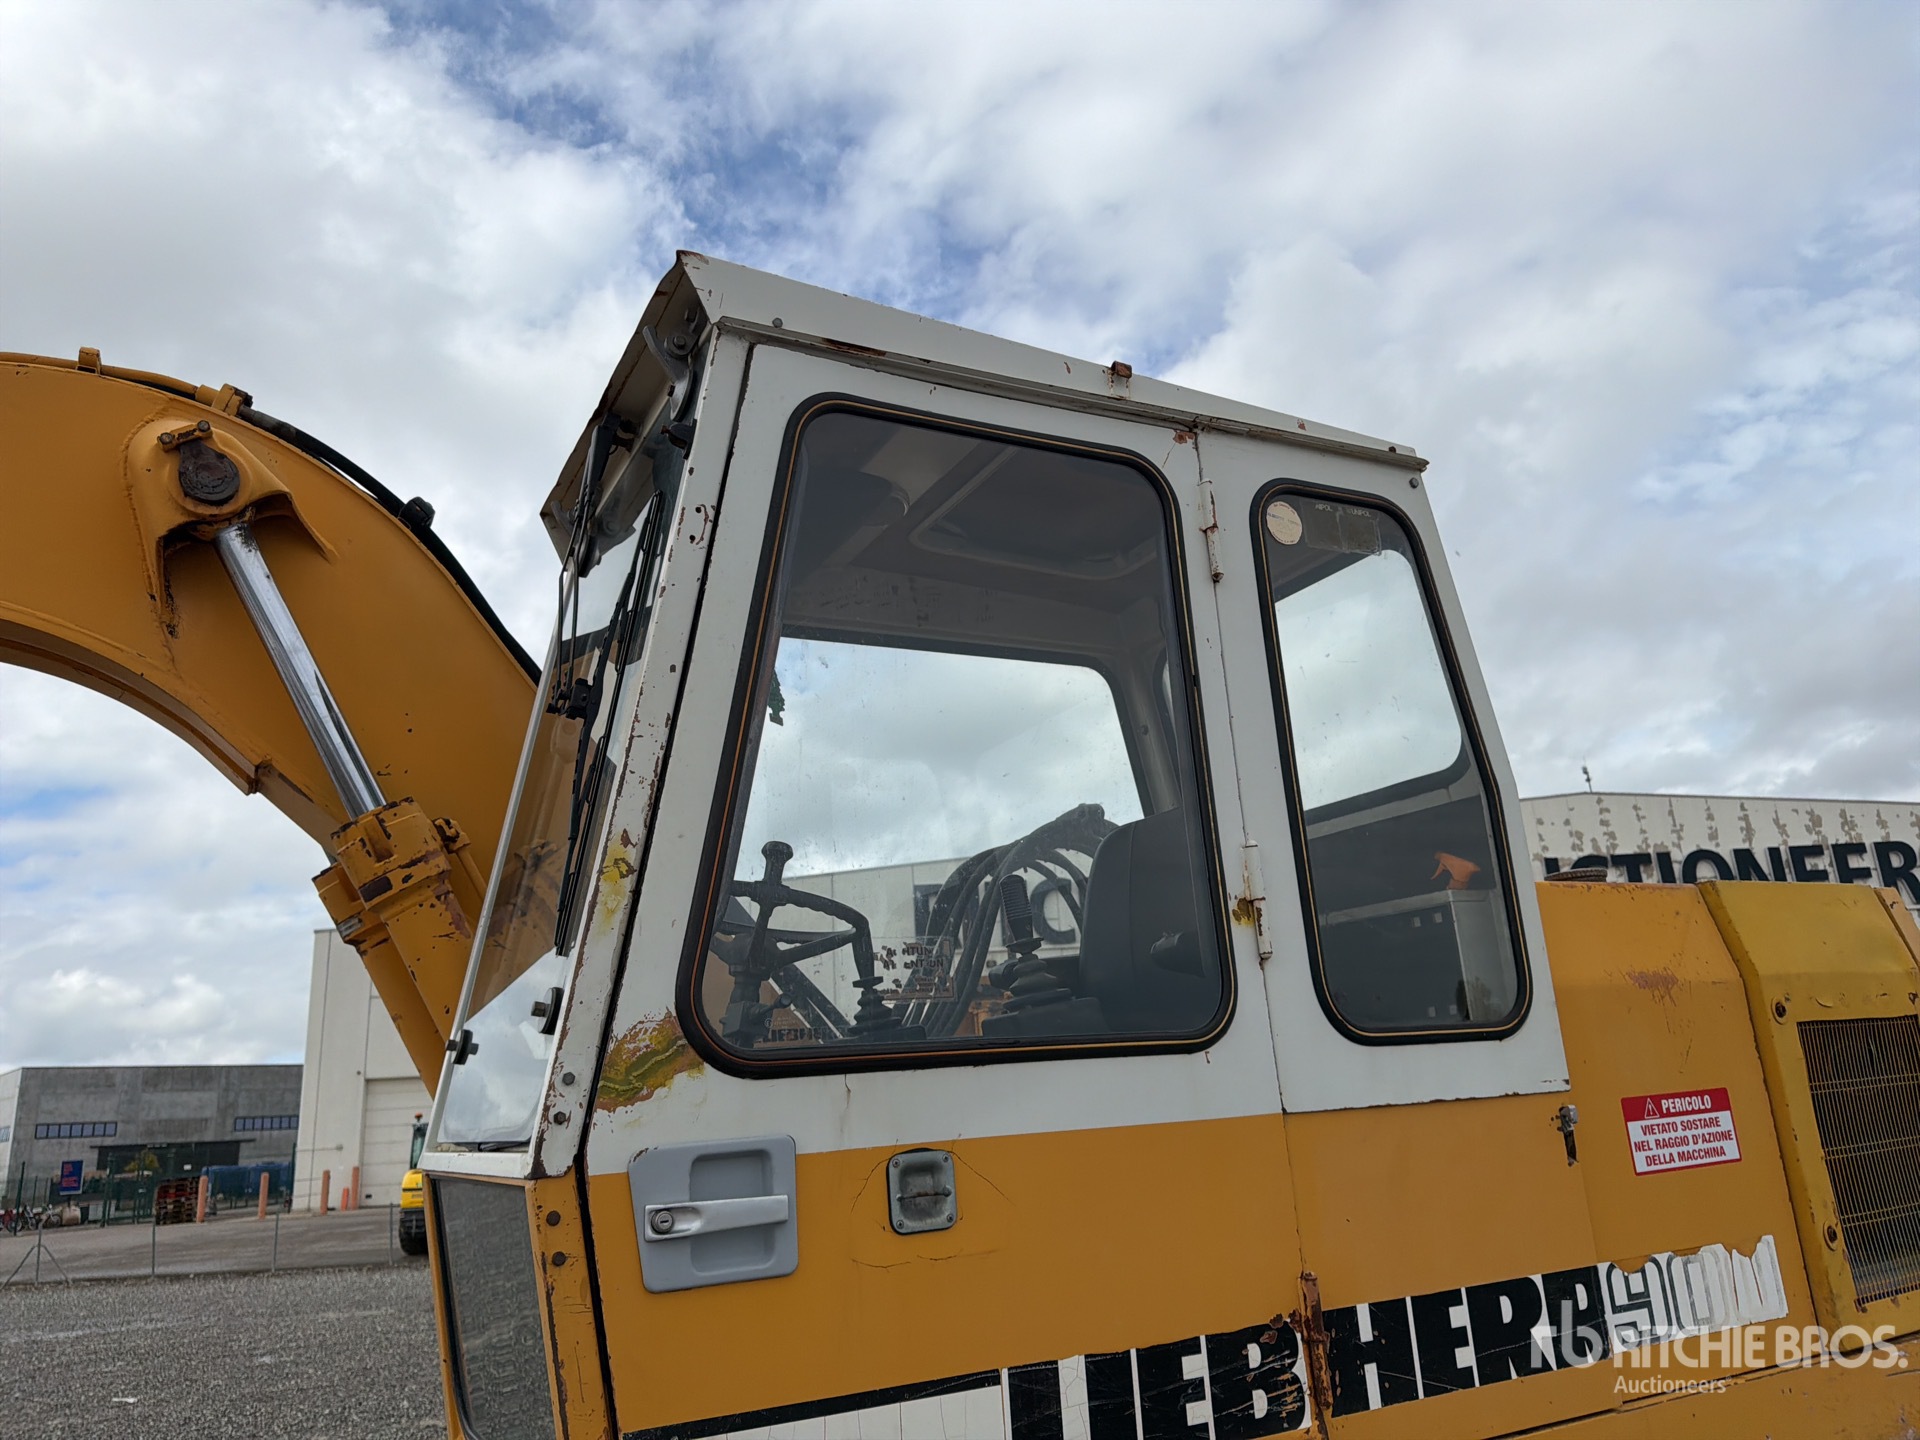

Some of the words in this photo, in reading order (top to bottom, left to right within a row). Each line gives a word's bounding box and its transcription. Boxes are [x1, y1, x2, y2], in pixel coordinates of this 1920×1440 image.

[1661, 1095, 1711, 1114] PERICOLO
[1641, 1121, 1678, 1136] VIETATO
[1680, 1116, 1721, 1132] SOSTARE
[1634, 1140, 1653, 1153] NEL
[1655, 1136, 1689, 1151] RAGGIO
[1692, 1130, 1734, 1145] D'AZIONE
[1645, 1153, 1676, 1167] DELLA
[1678, 1146, 1726, 1163] MACCHINA
